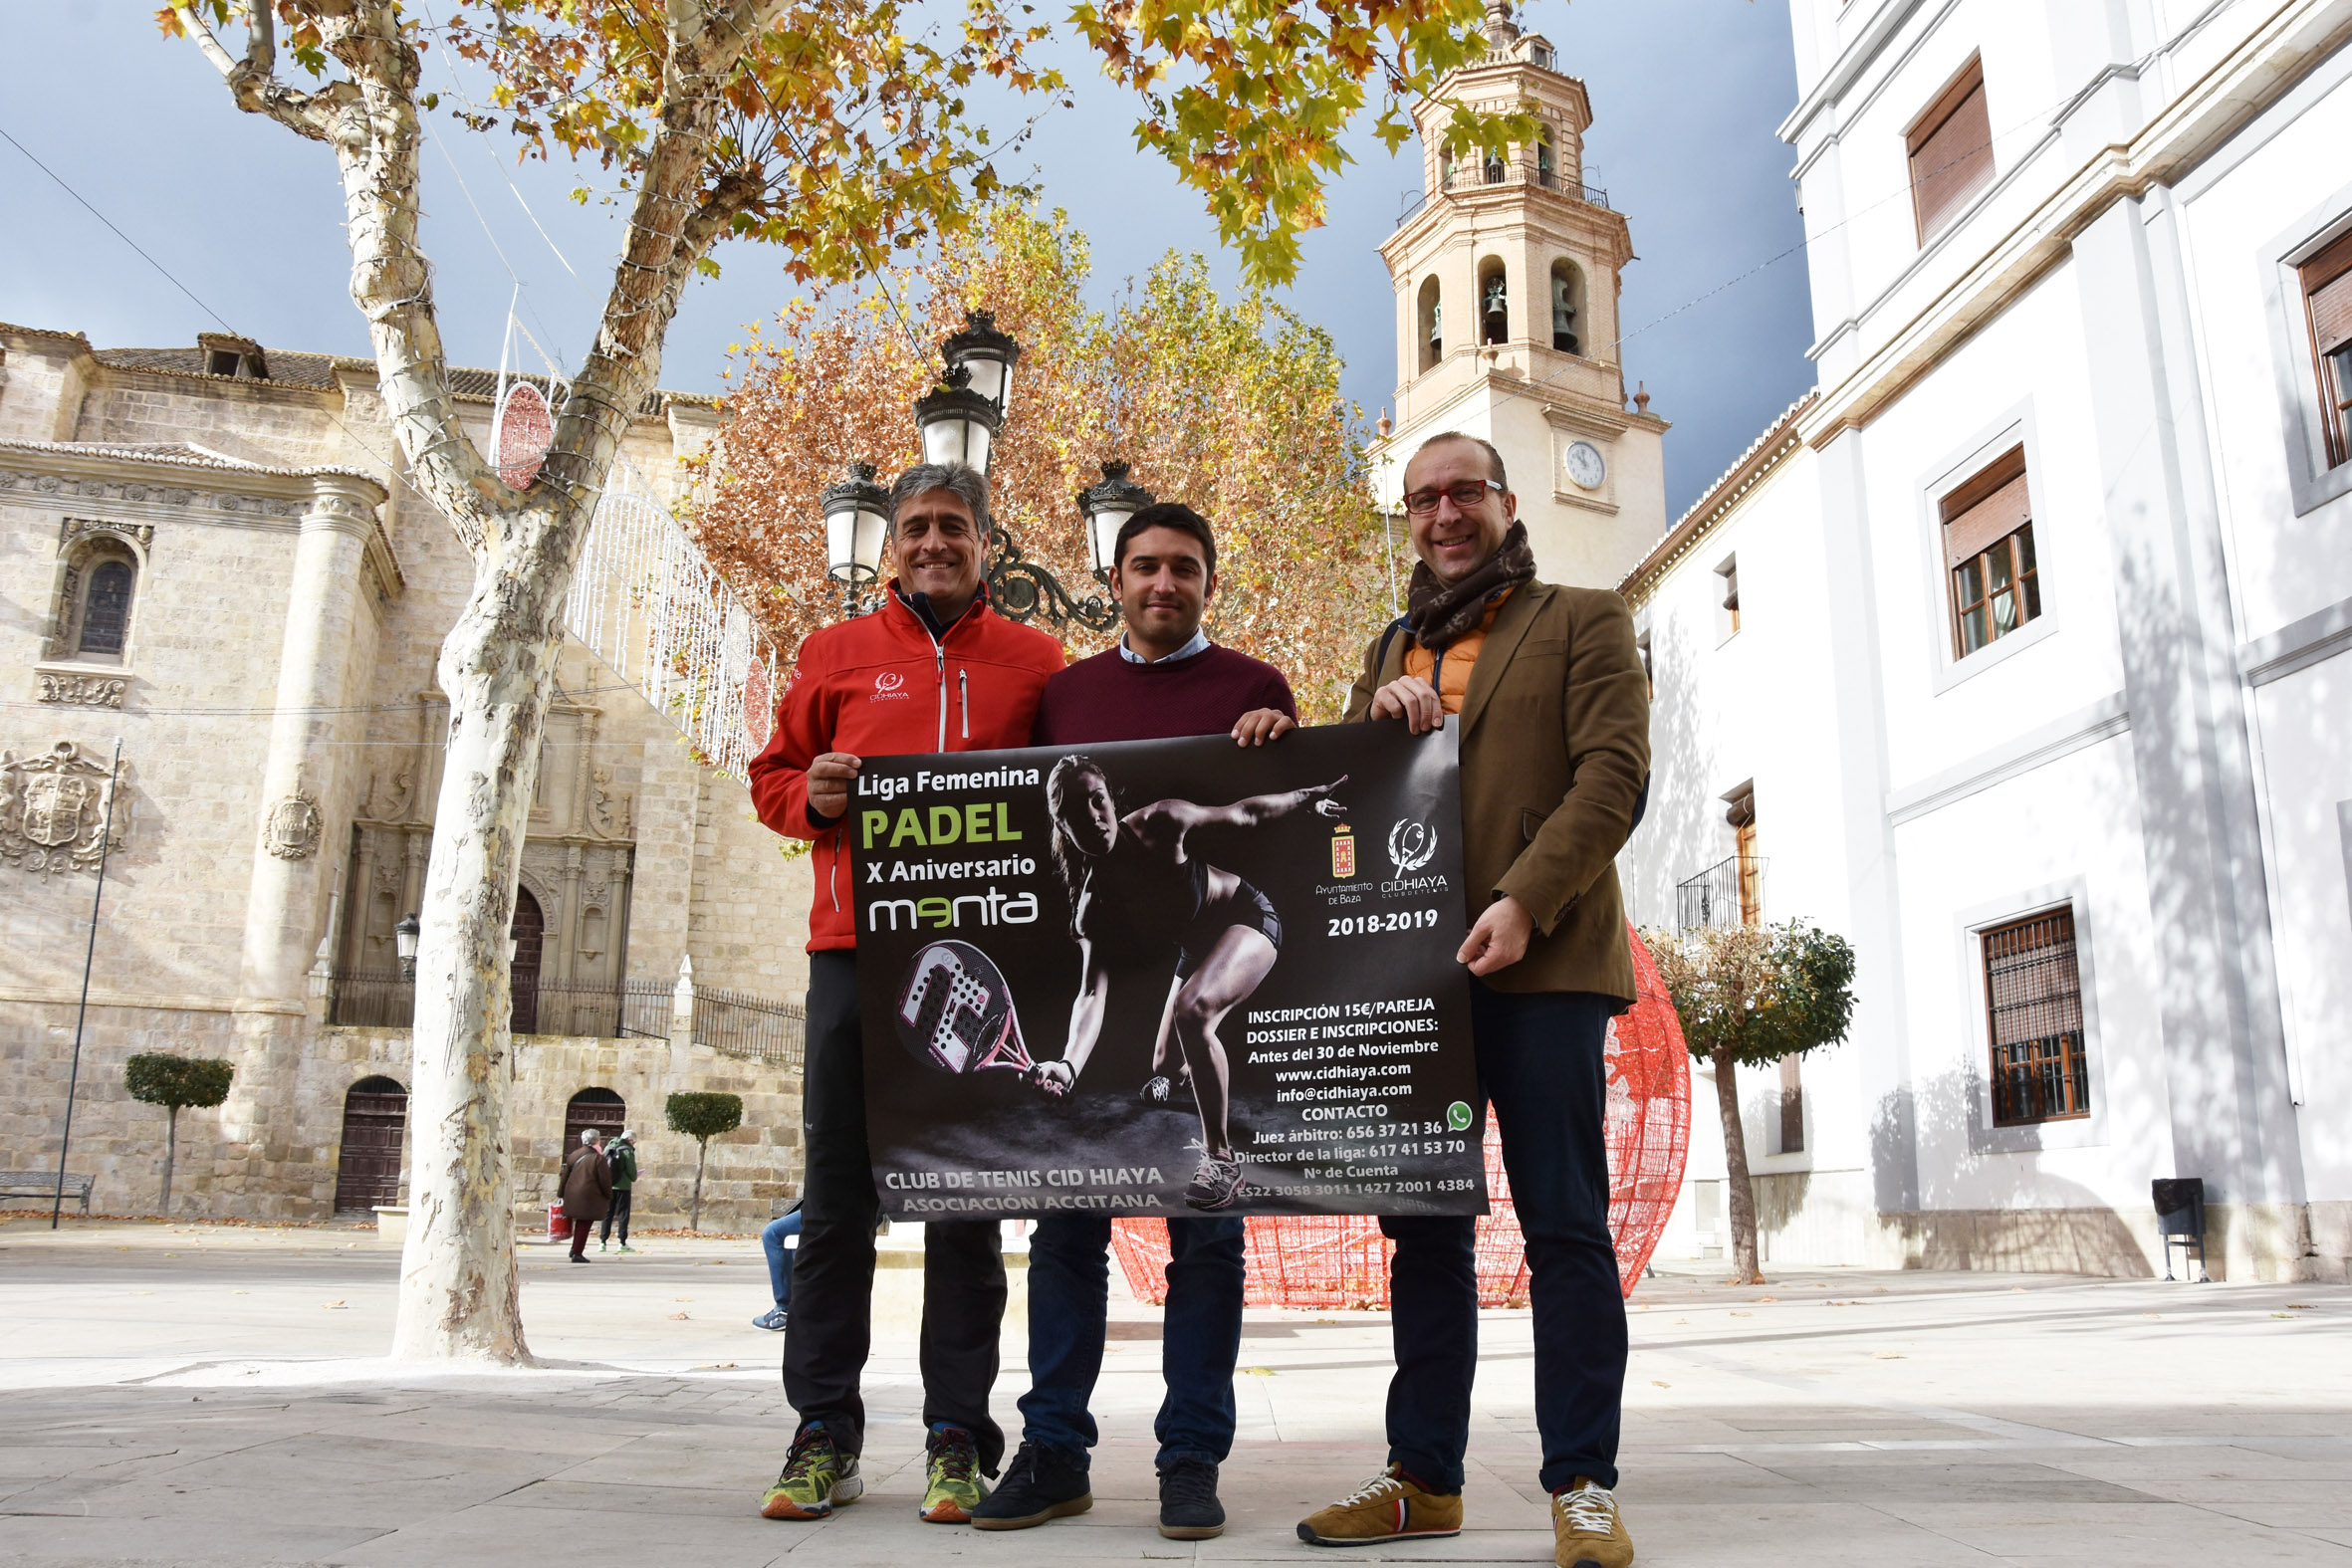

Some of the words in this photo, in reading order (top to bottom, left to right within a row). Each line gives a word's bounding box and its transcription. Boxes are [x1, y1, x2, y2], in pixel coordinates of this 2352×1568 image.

[858, 775, 909, 801] Liga
[917, 766, 1039, 792] Femenina
[862, 802, 1022, 848] PADEL
[866, 862, 883, 883] X
[889, 854, 1036, 882] Aniversario
[1381, 875, 1447, 892] CIDHIAYA
[1328, 909, 1438, 936] 2018-2019
[1249, 1004, 1339, 1023] INSCRIPCIÓN
[1344, 998, 1435, 1018] 15€/PAREJA
[1247, 1027, 1306, 1043] DOSSIER
[1310, 1027, 1318, 1039] E
[1322, 1018, 1438, 1038] INSCRIPCIONES:
[1248, 1051, 1289, 1064] Antes
[1293, 1047, 1312, 1061] del
[1316, 1046, 1334, 1059] 30
[1337, 1045, 1354, 1057] de
[1359, 1040, 1438, 1056] Noviembre
[1276, 1064, 1411, 1082] www.cidhiaya.com
[1278, 1084, 1412, 1102] info@cidhiaya.com
[1302, 1104, 1388, 1121] CONTACTO
[1253, 1132, 1285, 1144] Juez
[1289, 1129, 1342, 1143] árbitro:
[1346, 1125, 1374, 1139] 656
[1379, 1124, 1396, 1137] 37
[1401, 1123, 1418, 1136] 21
[1424, 1122, 1442, 1135] 36
[1235, 1152, 1293, 1163] Director
[1296, 1149, 1314, 1161] de
[1317, 1149, 1330, 1160] la
[1334, 1147, 1365, 1162] liga:
[1369, 1144, 1396, 1157] 617
[1401, 1143, 1418, 1155] 41
[1424, 1142, 1442, 1154] 53
[1446, 1140, 1465, 1153] 70
[885, 1172, 940, 1190] CLUB
[946, 1171, 974, 1189] DE
[978, 1170, 1042, 1188] TENIS
[1047, 1169, 1084, 1187] CID
[1089, 1167, 1165, 1186] HIAYA
[1325, 1167, 1342, 1178] de
[1346, 1165, 1398, 1177] Cuenta
[1237, 1187, 1272, 1197] ES22
[1276, 1186, 1310, 1197] 3058
[1315, 1185, 1350, 1195] 3011
[1356, 1183, 1391, 1194] 1427
[1396, 1181, 1432, 1193] 2001
[1437, 1179, 1474, 1191] 4384
[903, 1194, 1040, 1213] ASOCIACIÓN
[1045, 1194, 1163, 1210] ACCITANA
